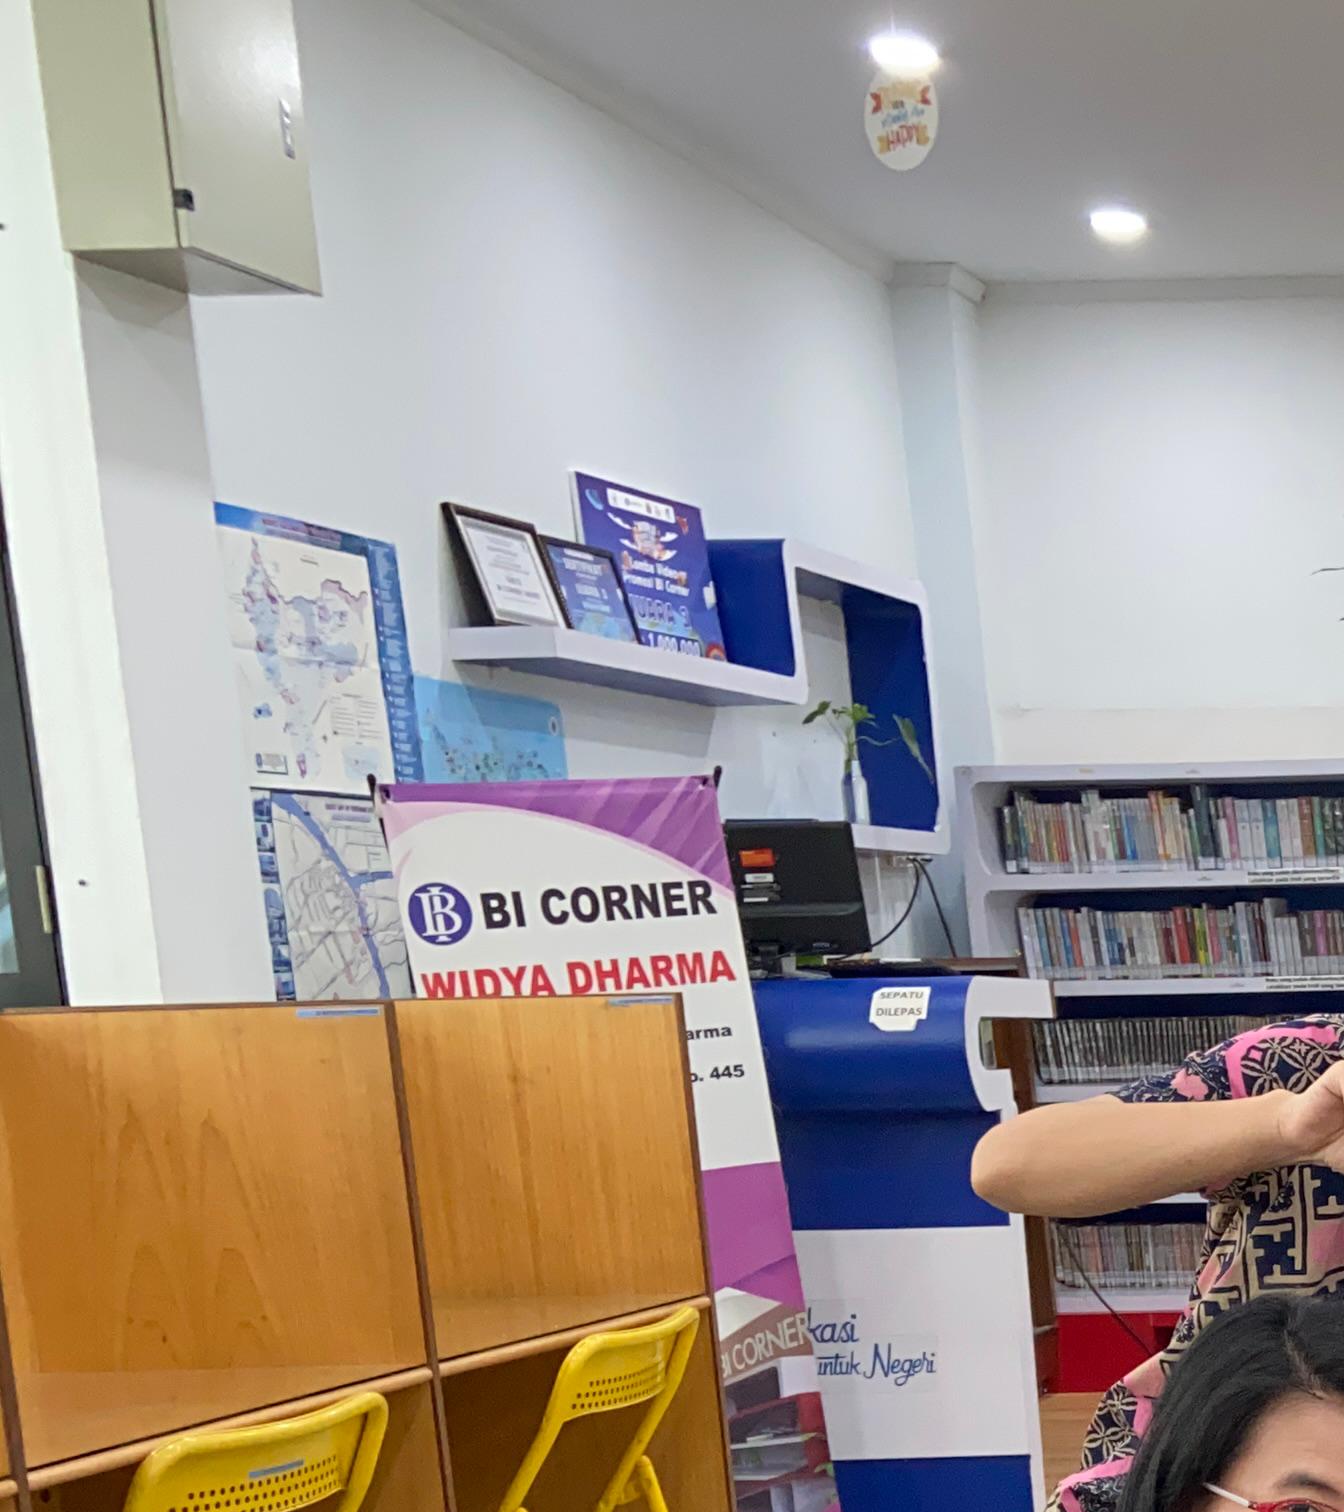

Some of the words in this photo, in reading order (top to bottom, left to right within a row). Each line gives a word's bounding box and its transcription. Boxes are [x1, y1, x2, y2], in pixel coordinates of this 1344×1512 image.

[480, 891, 527, 930] BI
[540, 880, 718, 925] CORNER
[421, 964, 557, 999] WIDYA
[566, 950, 737, 996] DHARMA
[880, 991, 924, 1000] SEPATU
[875, 1007, 922, 1017] DILEPAS
[709, 1064, 745, 1080] 445
[731, 1311, 810, 1370] CORNER
[863, 1343, 936, 1387] Negeri
